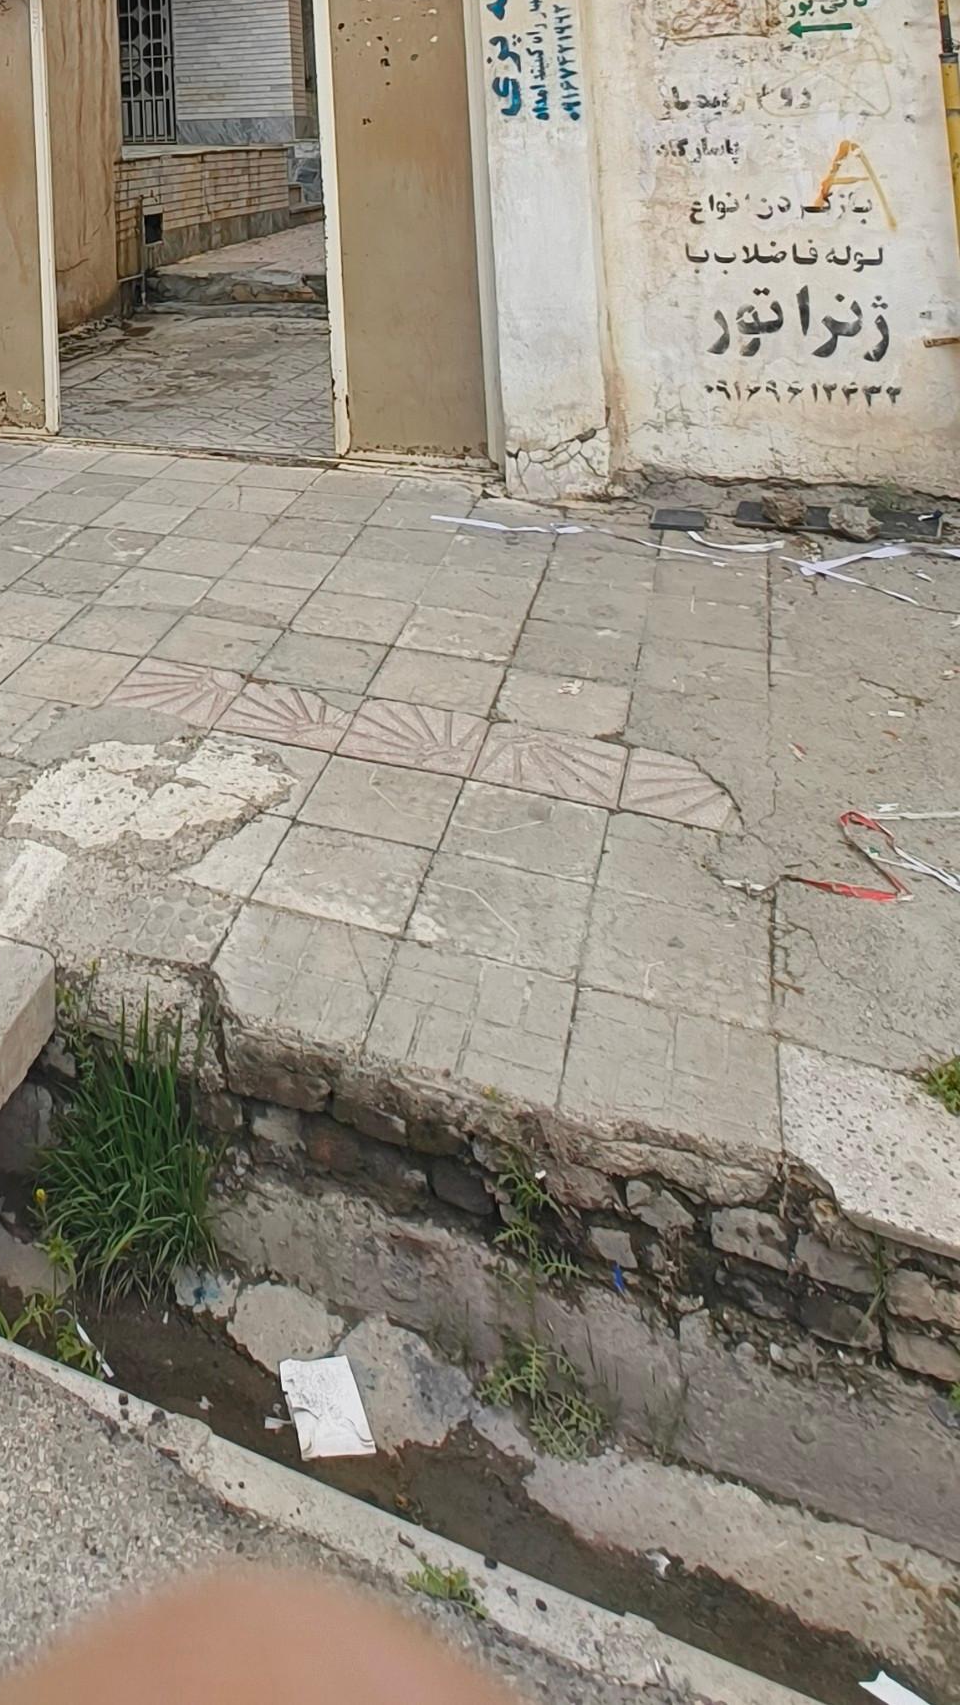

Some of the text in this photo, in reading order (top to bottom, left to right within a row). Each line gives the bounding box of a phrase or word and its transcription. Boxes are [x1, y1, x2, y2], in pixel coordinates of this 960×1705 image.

[488, 34, 522, 117] پزی
[825, 246, 884, 273] لوله
[707, 285, 889, 363] ژنراتور
